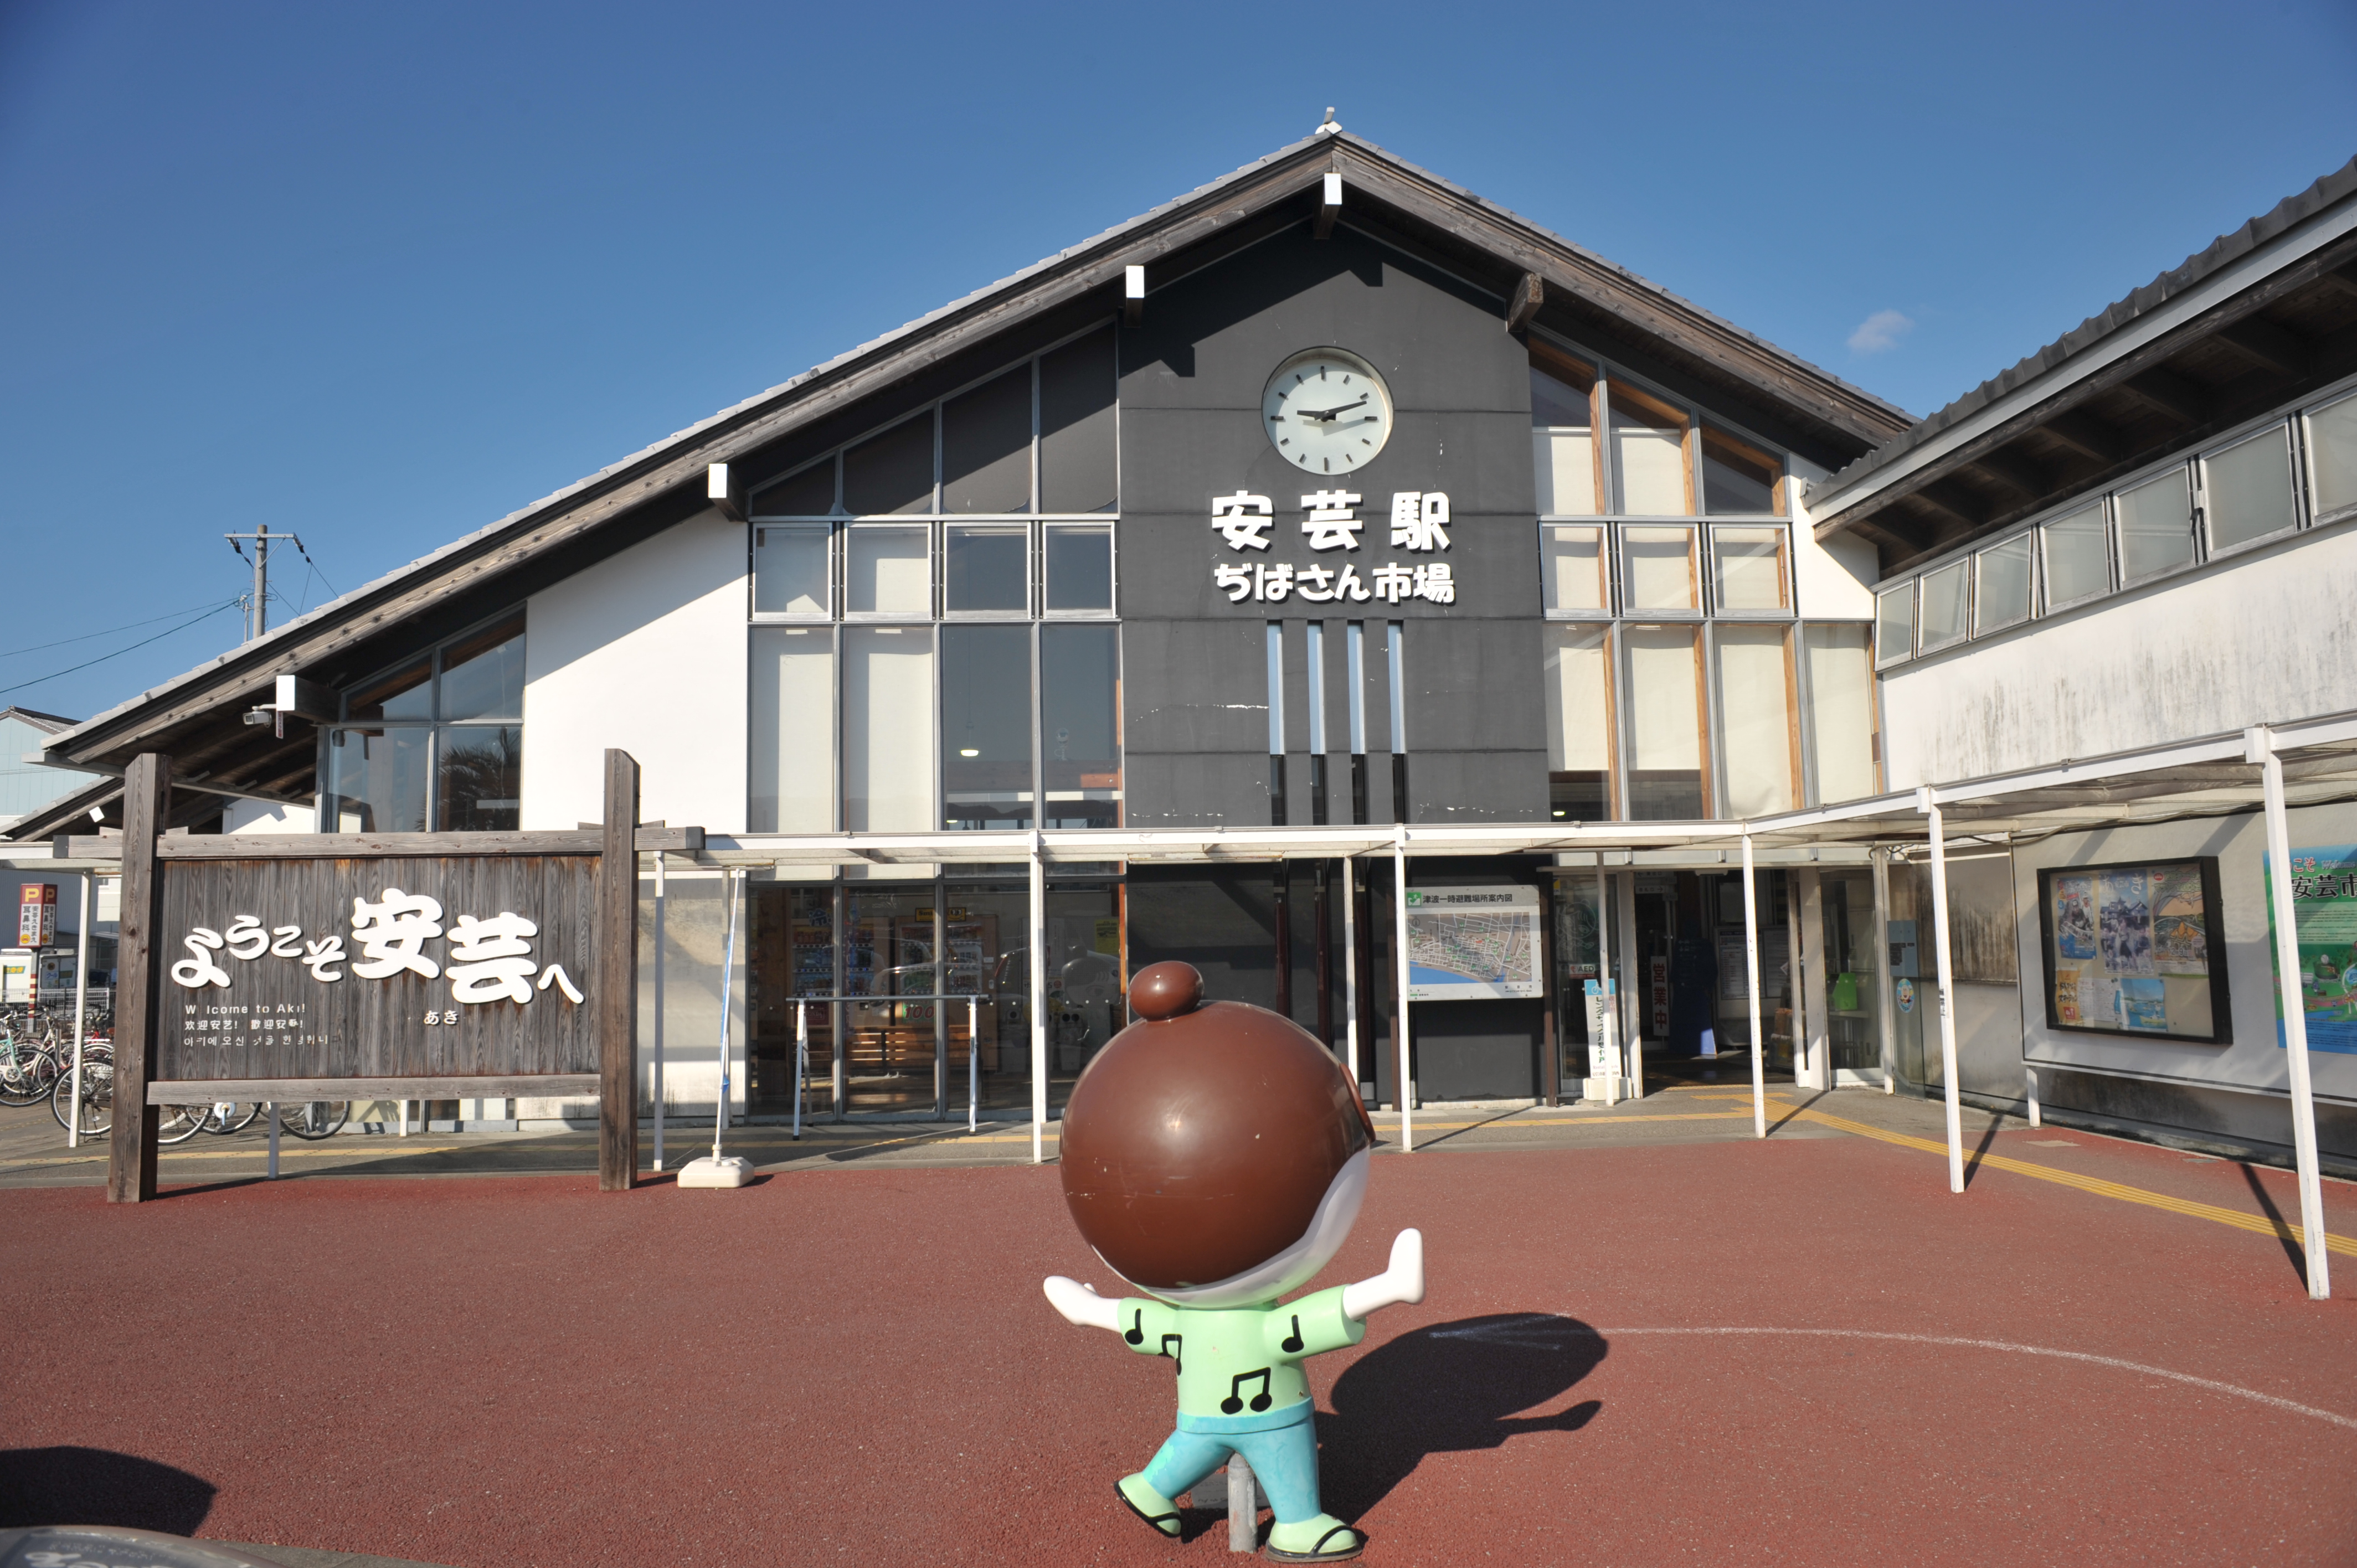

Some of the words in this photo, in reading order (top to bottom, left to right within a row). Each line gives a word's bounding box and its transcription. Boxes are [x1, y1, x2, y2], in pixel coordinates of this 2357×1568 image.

[1212, 490, 1450, 550] 安芸駅
[1214, 563, 1454, 604] ぢばさん市場
[25, 888, 39, 902] P
[45, 889, 54, 902] P
[1423, 894, 1512, 904] 津波一時避難場所案内図
[1653, 963, 1667, 1029] 営業中
[256, 1004, 269, 1013] to
[424, 1010, 457, 1025] あき
